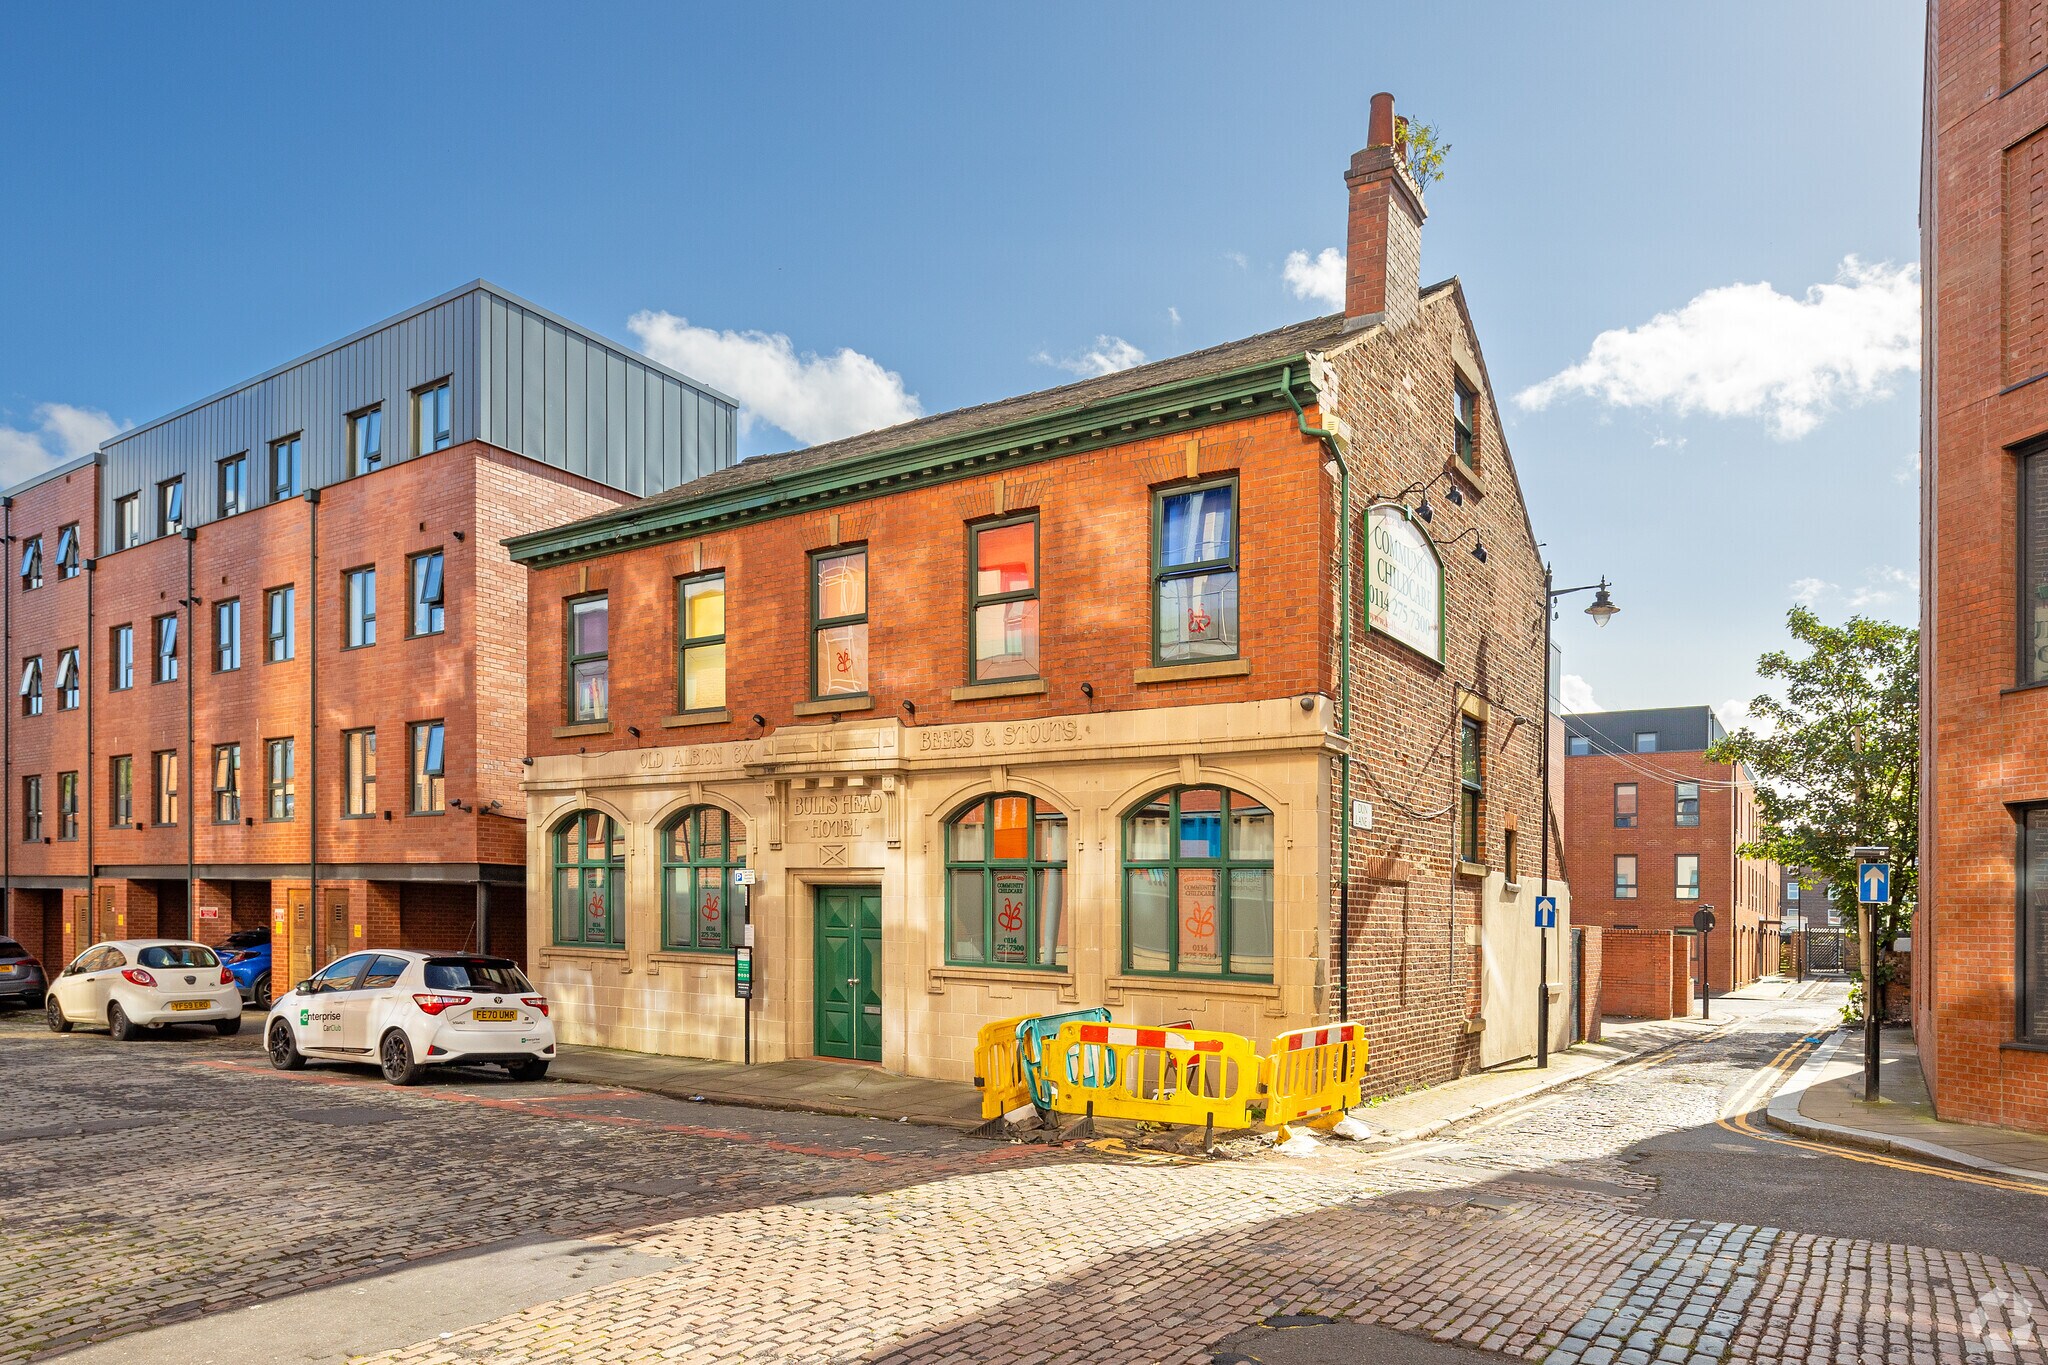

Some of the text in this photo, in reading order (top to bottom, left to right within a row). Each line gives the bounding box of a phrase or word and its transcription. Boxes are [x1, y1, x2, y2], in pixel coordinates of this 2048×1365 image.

[1374, 525, 1434, 588] COMMUNITY
[1377, 557, 1432, 613] CHILDCARE
[1369, 584, 1390, 612] 0114
[1392, 598, 1409, 624] 275
[1411, 608, 1431, 636] 7300
[920, 727, 974, 751] BEERS
[984, 728, 995, 747] &
[640, 751, 663, 769] OLD
[672, 747, 722, 768] ALBION
[793, 793, 883, 815] BULLS HEAD
[300, 1010, 341, 1023] enterprise
[476, 1010, 515, 1019] FE70 UMR
